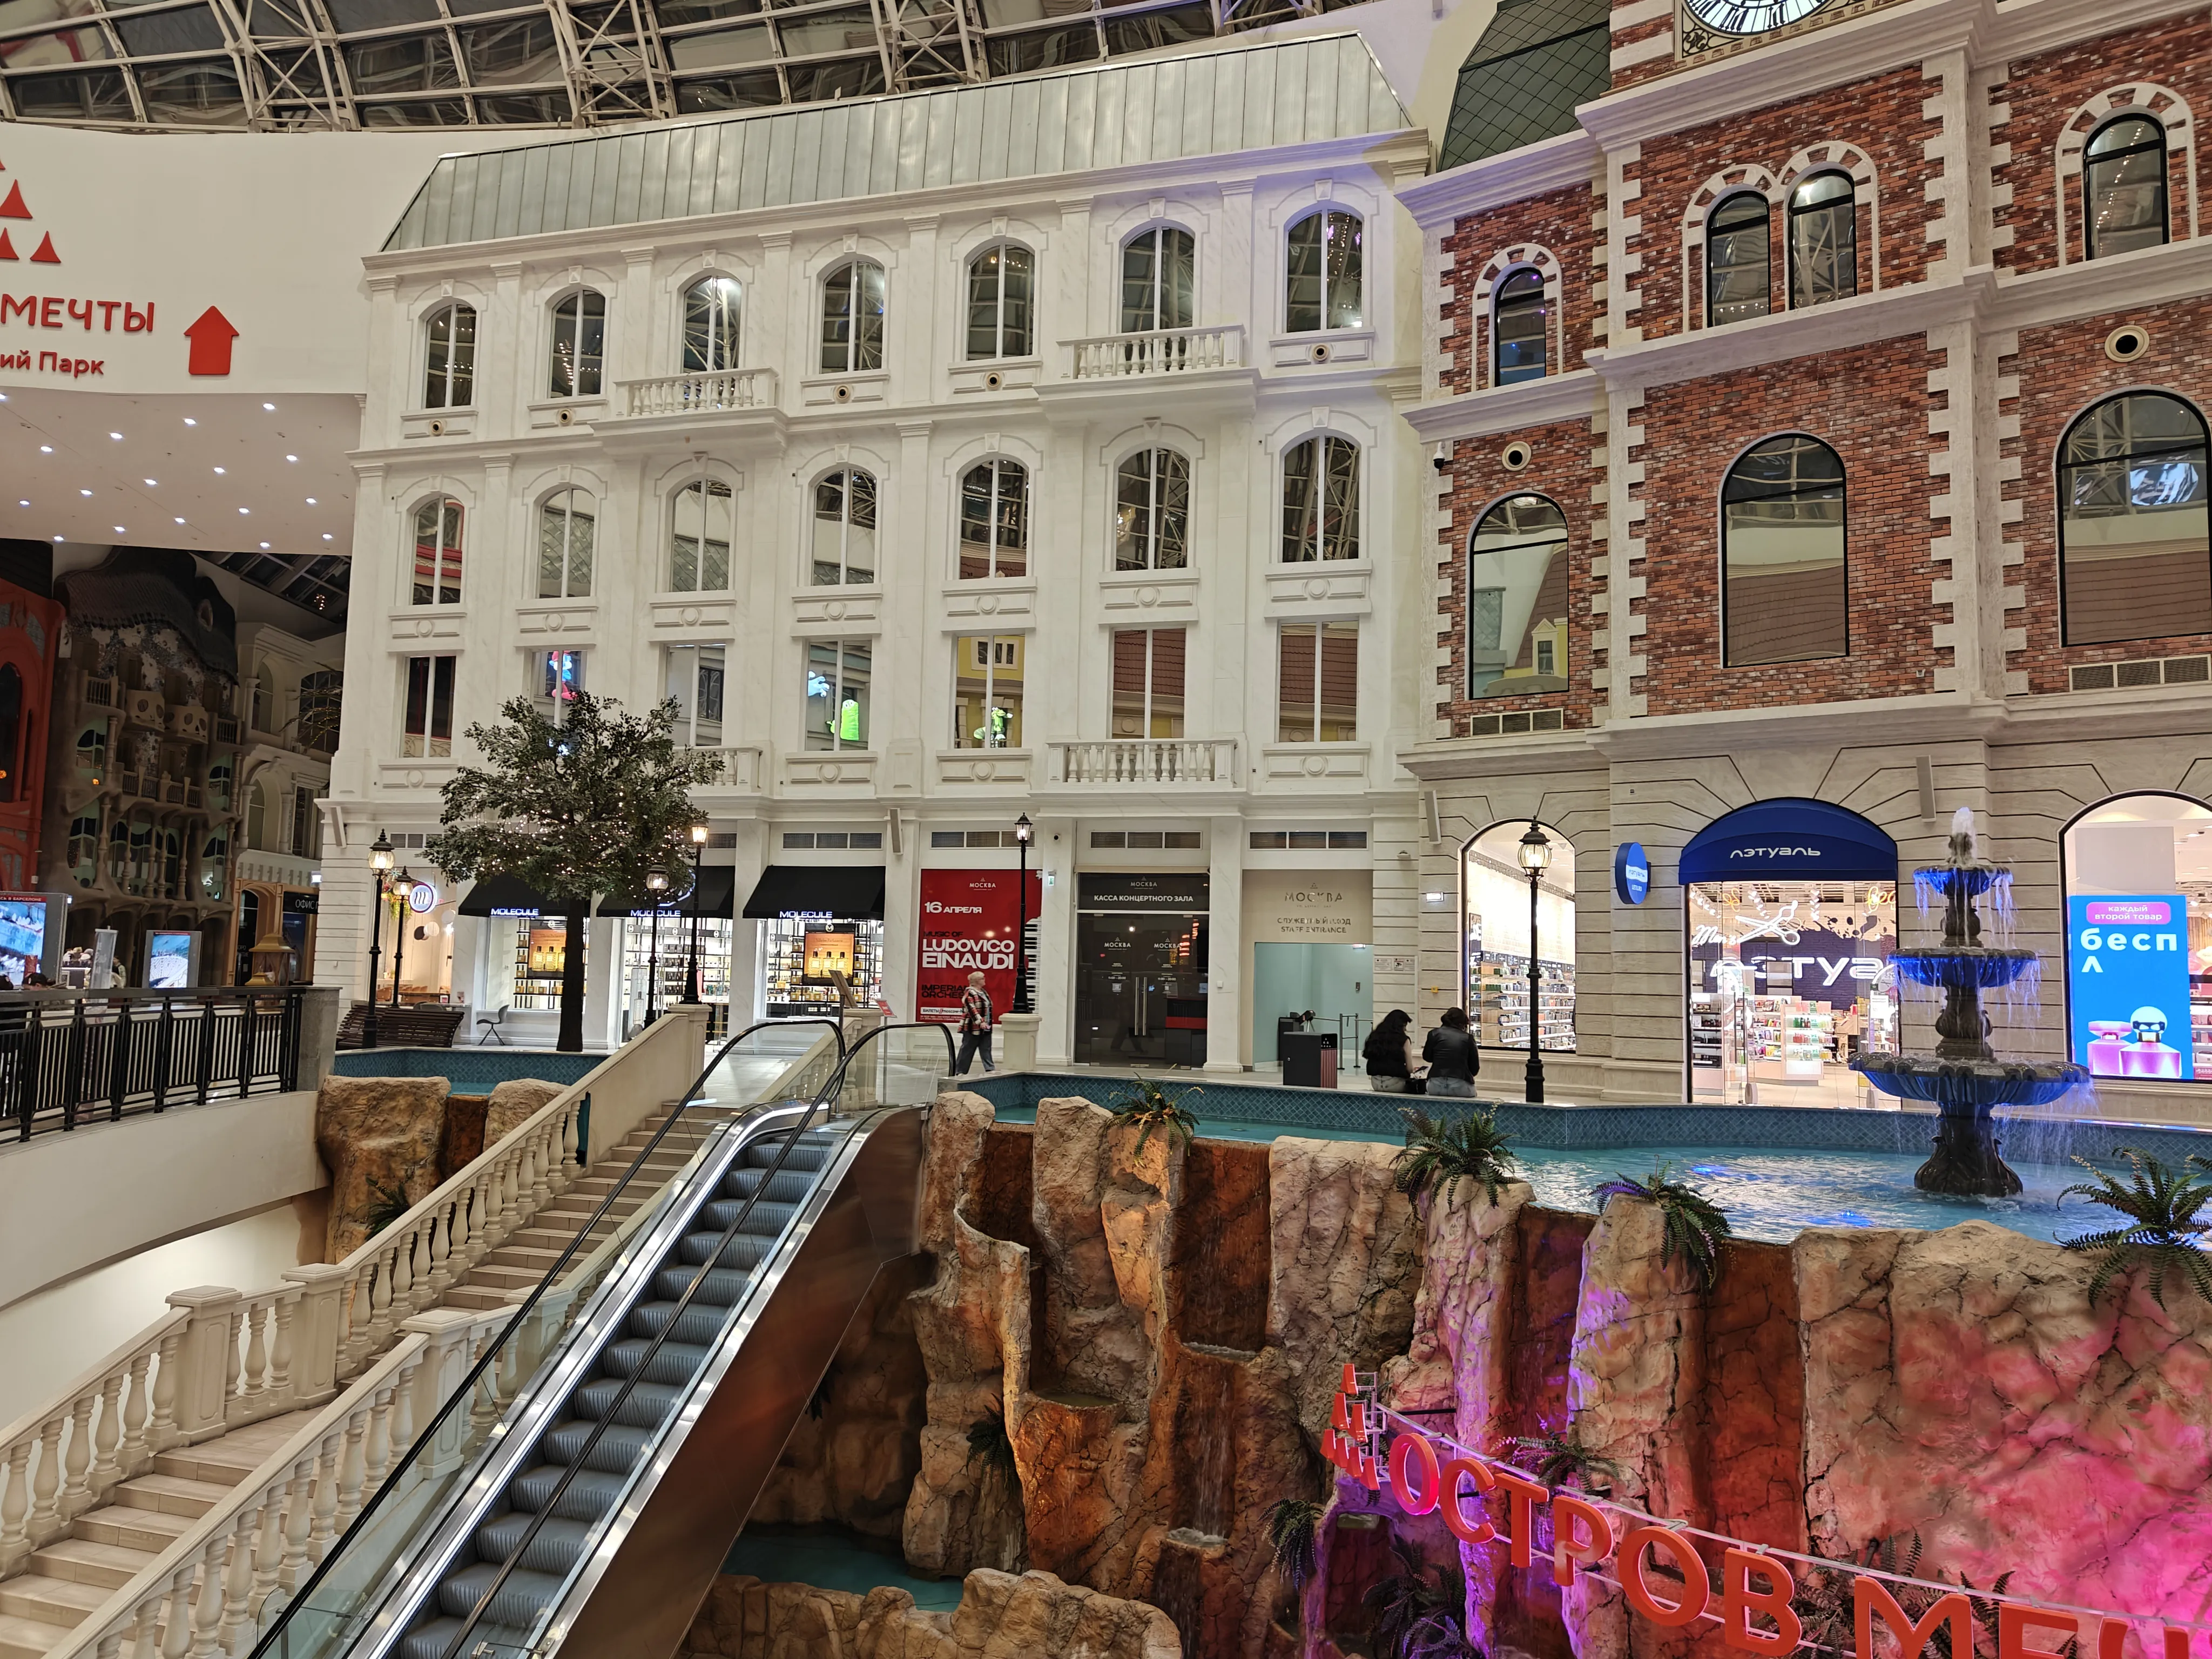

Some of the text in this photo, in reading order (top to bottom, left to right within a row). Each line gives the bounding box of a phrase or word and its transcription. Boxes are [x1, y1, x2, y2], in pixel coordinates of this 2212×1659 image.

[1, 293, 155, 332] МЕЧТЫ
[0, 349, 104, 379] ий Парк
[295, 899, 314, 909] ОФИС
[1285, 892, 1343, 902] МОСКВА
[925, 901, 942, 913] 16
[922, 939, 1015, 953] LUDOVICO
[2080, 927, 2177, 951] бесп
[922, 953, 1014, 969] EINAUDI
[1389, 1433, 1802, 1657] ОСТРОВ
